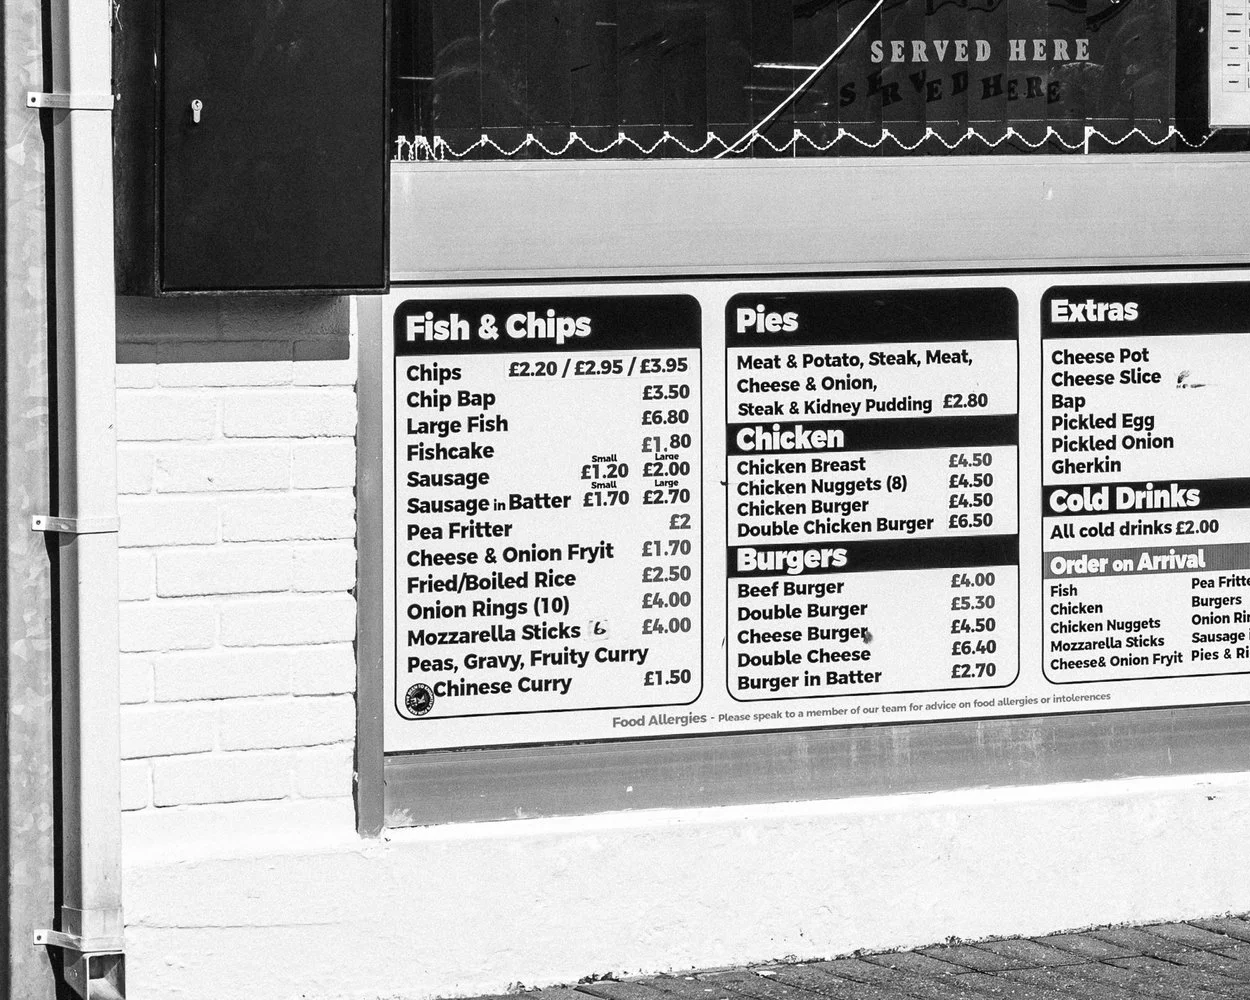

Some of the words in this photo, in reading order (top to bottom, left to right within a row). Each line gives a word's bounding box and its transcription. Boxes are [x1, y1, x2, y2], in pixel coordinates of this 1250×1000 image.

[871, 40, 990, 62] SERVED
[1009, 39, 1089, 61] HERE
[737, 304, 798, 332] Pies
[1051, 299, 1138, 322] Extras
[407, 312, 469, 341] Fish
[479, 314, 499, 340] &
[506, 309, 591, 344] Chips
[509, 362, 557, 377] £2.20
[575, 360, 623, 375] £2.95
[640, 358, 687, 373] £3.95
[738, 355, 781, 370] Meat
[787, 354, 797, 368] &
[803, 353, 864, 369] Potato,
[869, 350, 921, 367] Steak,
[926, 350, 972, 366] Meat,
[407, 362, 461, 385] Chips
[1052, 371, 1114, 386] Cheese
[1120, 367, 1161, 384] Slice
[738, 401, 784, 416] Steak
[789, 402, 799, 414] &
[805, 399, 861, 416] Kidney
[866, 396, 932, 414] Pudding
[943, 393, 988, 408] £2.80
[408, 418, 461, 438] Large
[468, 414, 508, 432] Fish
[642, 410, 688, 425] £6.80
[1052, 413, 1116, 430] Pickled
[1122, 414, 1154, 431] Egg
[737, 424, 844, 450] Chicken
[408, 442, 494, 461] Fishcake
[592, 454, 617, 462] Small
[1052, 456, 1121, 474] Gherkin
[738, 479, 806, 496] Chicken
[812, 478, 881, 496] Nuggets
[887, 475, 907, 492] (8)
[949, 473, 993, 488] £4.50
[407, 498, 490, 516] Sausage
[494, 499, 505, 510] in
[510, 494, 571, 510] Batter
[584, 491, 629, 507] £1.70
[643, 489, 690, 504] £2.70
[1050, 486, 1108, 512] Cold
[1116, 483, 1200, 510] Drinks
[738, 521, 798, 537] Double
[804, 518, 871, 534] Chicken
[877, 518, 934, 534] Burger
[949, 513, 992, 528] £6.50
[1050, 524, 1075, 539] All
[1080, 522, 1114, 537] cold
[1120, 520, 1172, 536] drinks
[1176, 520, 1219, 535] £2.00
[407, 550, 478, 566] Cheese
[485, 548, 497, 563] &
[503, 543, 561, 562] Onion
[568, 540, 614, 563] Fryit
[642, 540, 691, 556] £1.70
[738, 548, 847, 574] Burgers
[1050, 554, 1108, 574] Order
[1112, 560, 1133, 571] on
[1137, 549, 1206, 570] Arrival
[408, 571, 528, 594] Fried/Boiled
[535, 569, 576, 587] Rice
[642, 566, 691, 582] £2.50
[1051, 584, 1077, 597] Fish
[1192, 578, 1214, 589] Pea
[408, 625, 515, 646] Mozzarella
[522, 622, 580, 640] Sticks
[642, 617, 691, 634] £4.00
[1051, 637, 1121, 652] Mozzarella
[1126, 634, 1164, 647] Sticks
[1192, 632, 1245, 644] Sausage
[408, 657, 458, 673] Peas,
[464, 654, 524, 671] Gravy,
[531, 646, 589, 668] Fruity
[595, 648, 648, 665] Curry
[1051, 657, 1106, 670] Cheese&
[1110, 653, 1148, 666] Onion
[1153, 651, 1183, 666] Fryit
[1192, 648, 1218, 661] Pies
[1224, 648, 1231, 659] &
[434, 677, 512, 697] Chinese
[518, 678, 572, 694] Curry
[644, 669, 691, 686] £1.50
[738, 676, 799, 692] Burger
[805, 671, 820, 686] in
[827, 670, 882, 685] Batter
[952, 663, 996, 678] £2.70
[613, 716, 645, 728] Food
[648, 712, 706, 726] Allergies
[719, 714, 750, 722] Please
[754, 711, 782, 722] speak
[807, 708, 848, 716] member
[850, 706, 860, 714] of
[909, 703, 923, 711] for
[926, 700, 956, 710] advice
[974, 698, 994, 707] food
[998, 696, 1038, 706] allergies
[1053, 694, 1110, 703] intolerences
